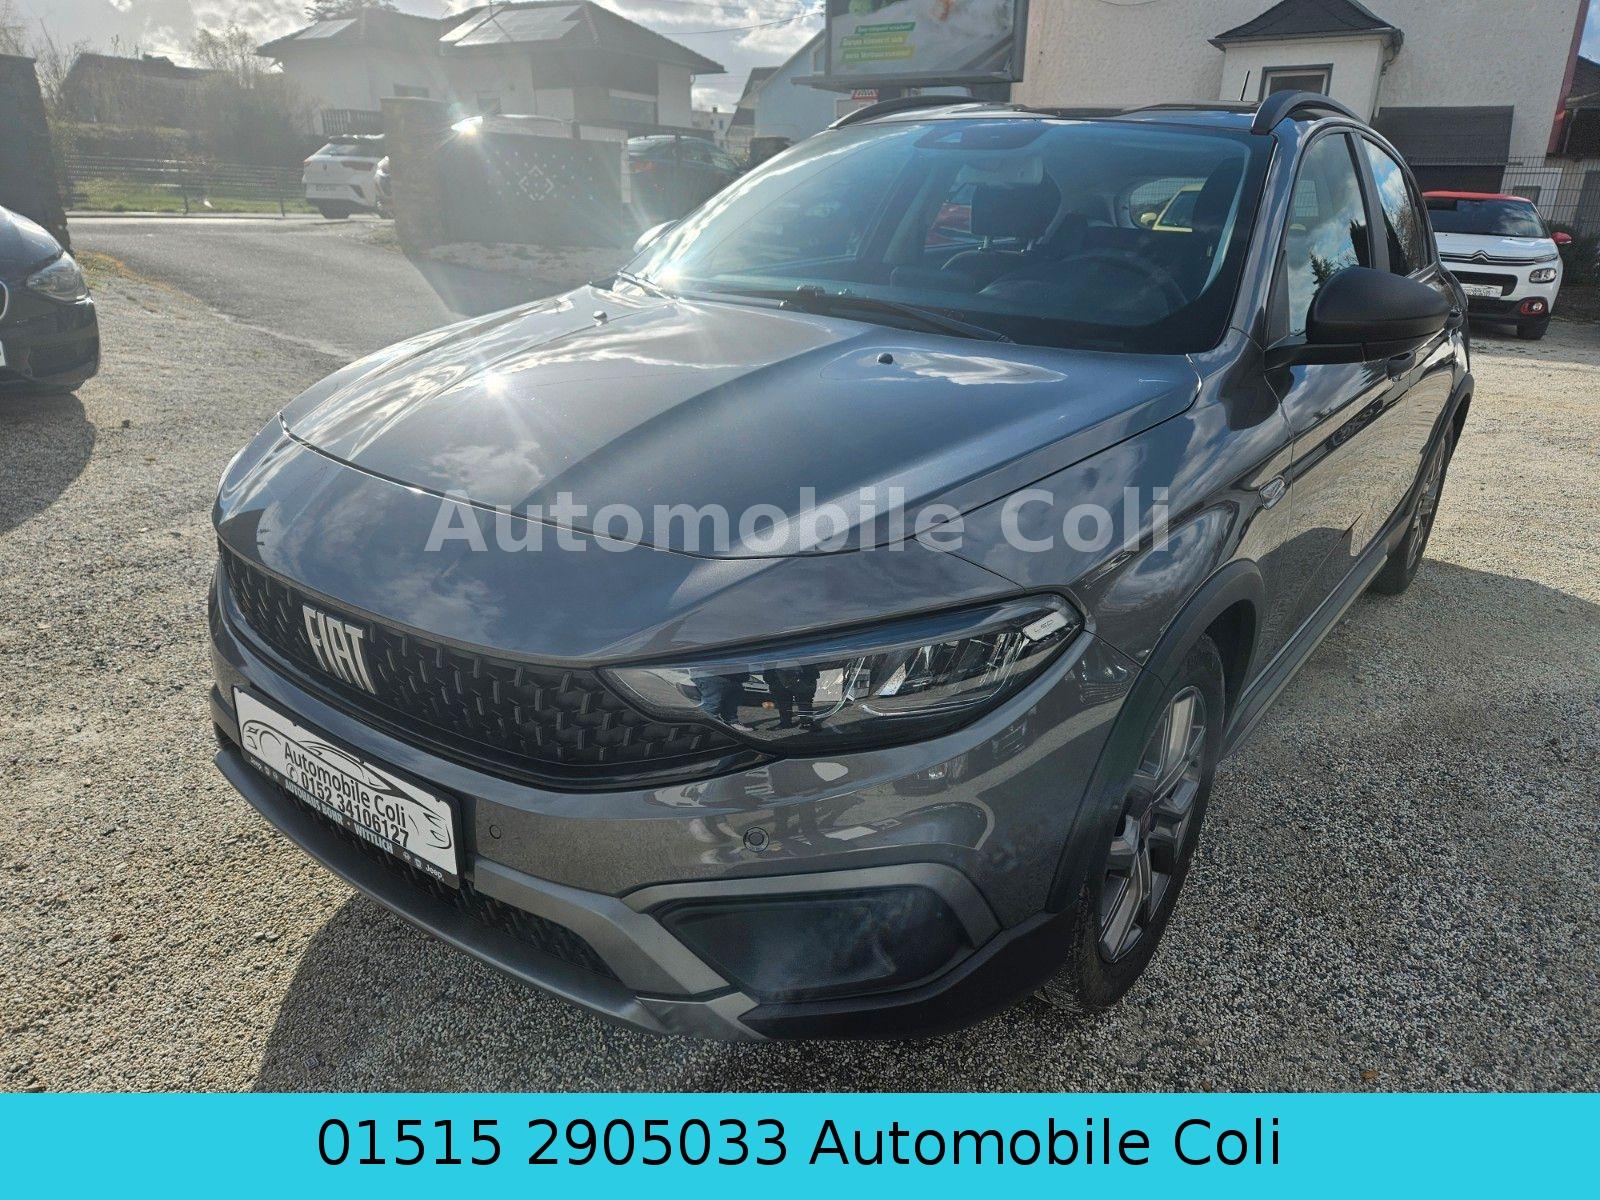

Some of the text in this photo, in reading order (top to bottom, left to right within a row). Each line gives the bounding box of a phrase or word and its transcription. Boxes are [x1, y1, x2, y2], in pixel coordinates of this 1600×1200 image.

[302, 604, 376, 695] FIAT
[284, 741, 406, 828] Automobile Coli
[300, 771, 409, 848] 0152 34106127
[353, 822, 394, 855] WITTLICH
